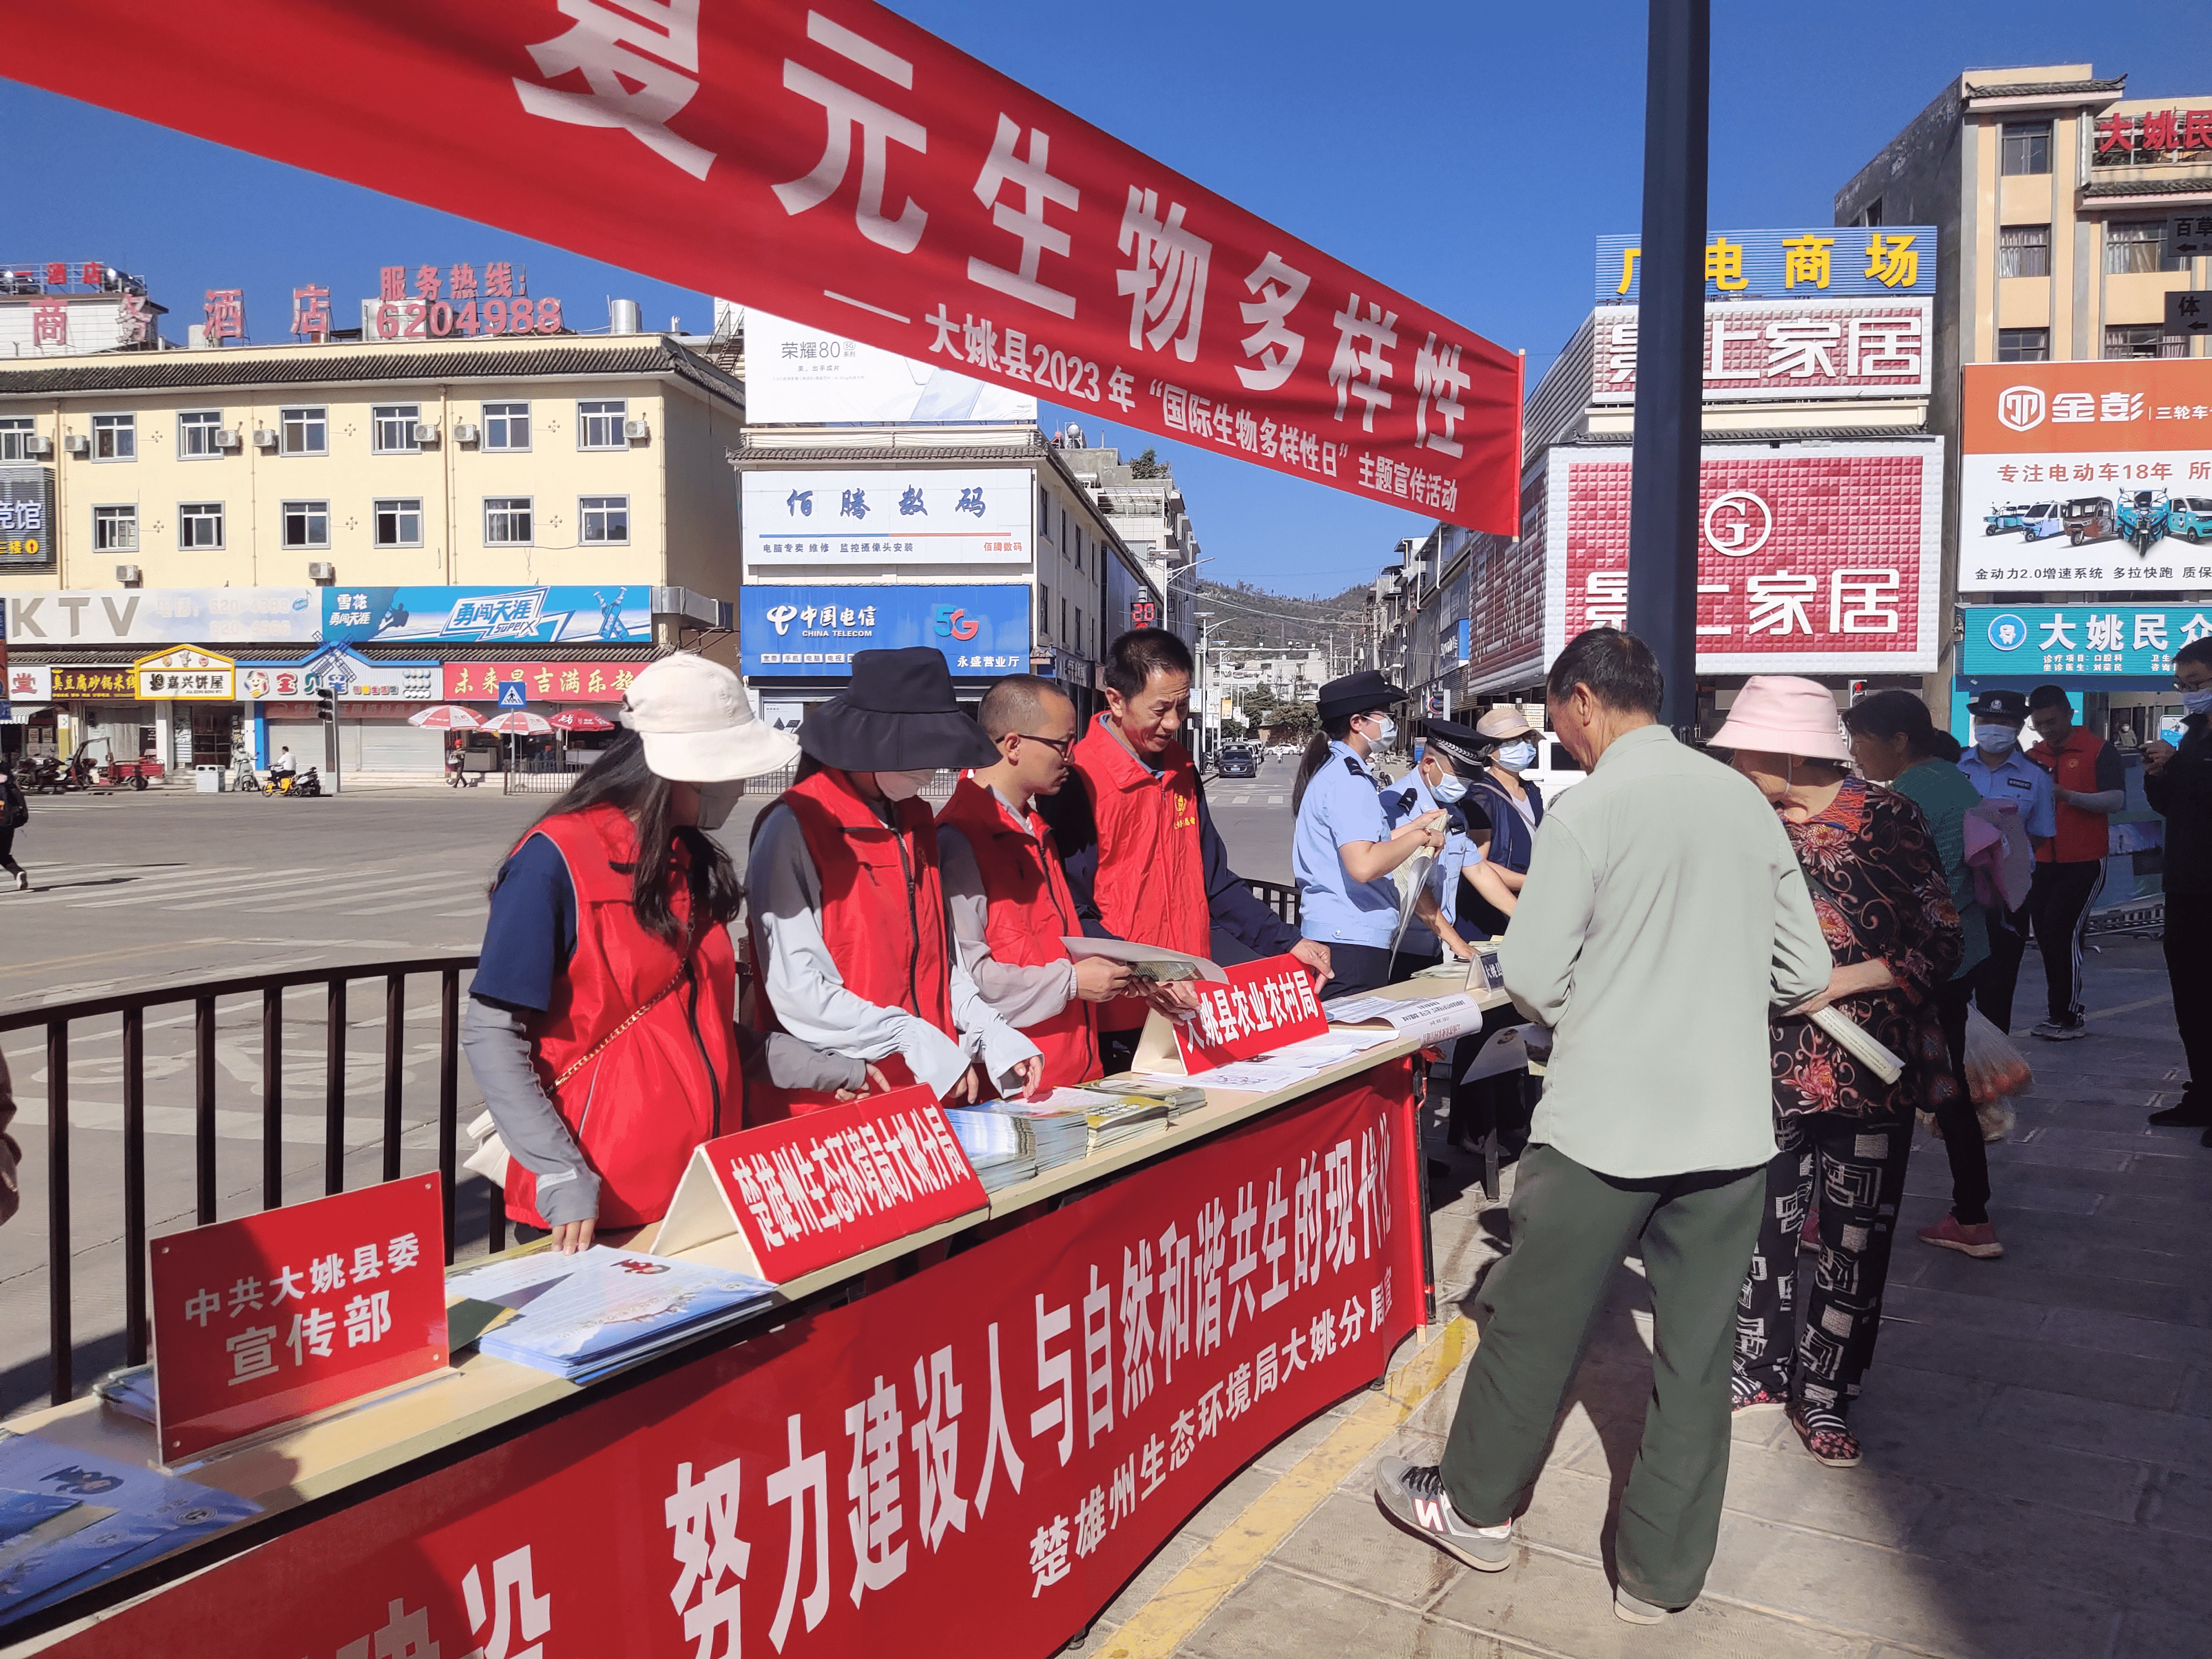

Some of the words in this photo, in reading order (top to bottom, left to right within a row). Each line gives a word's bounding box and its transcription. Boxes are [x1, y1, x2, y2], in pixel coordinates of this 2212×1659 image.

[29, 283, 331, 346] 商务酒店
[376, 297, 561, 338] 6204988
[781, 341, 841, 359] 荣耀80
[2052, 392, 2144, 423] 金彭
[2156, 405, 2212, 420] 三轮车
[1997, 461, 2173, 483] 专注电动车18年
[2188, 461, 2211, 481] 所
[786, 484, 986, 519] 佰腾数码
[763, 542, 804, 554] 电脑专卖
[809, 542, 830, 553] 维修
[839, 542, 914, 553] 监控摄像头安装
[984, 541, 1023, 552] 佰腾数码
[1975, 567, 2103, 580] 金动力2.0增速系统
[2113, 567, 2174, 579] 多拉快跑
[337, 593, 368, 610] 雪花
[454, 599, 534, 626] 勇闯天涯
[1133, 603, 1155, 621] 20
[12, 596, 140, 638] KTV
[329, 612, 372, 627] 勇闯天涯
[800, 605, 877, 629] 中国电信
[933, 607, 980, 641] 5G
[957, 655, 1020, 668] 永盛营业厅
[2151, 663, 2177, 671] 咨询
[11, 672, 38, 695] 堂
[167, 675, 223, 690] 嘉兴饼屋
[1179, 970, 1319, 1054] 大姚县农业农村局
[731, 1103, 971, 1252] 楚雄州生态环境局大姚分局
[185, 1232, 420, 1327] 中共大姚县委
[226, 1290, 392, 1386] 宣传部
